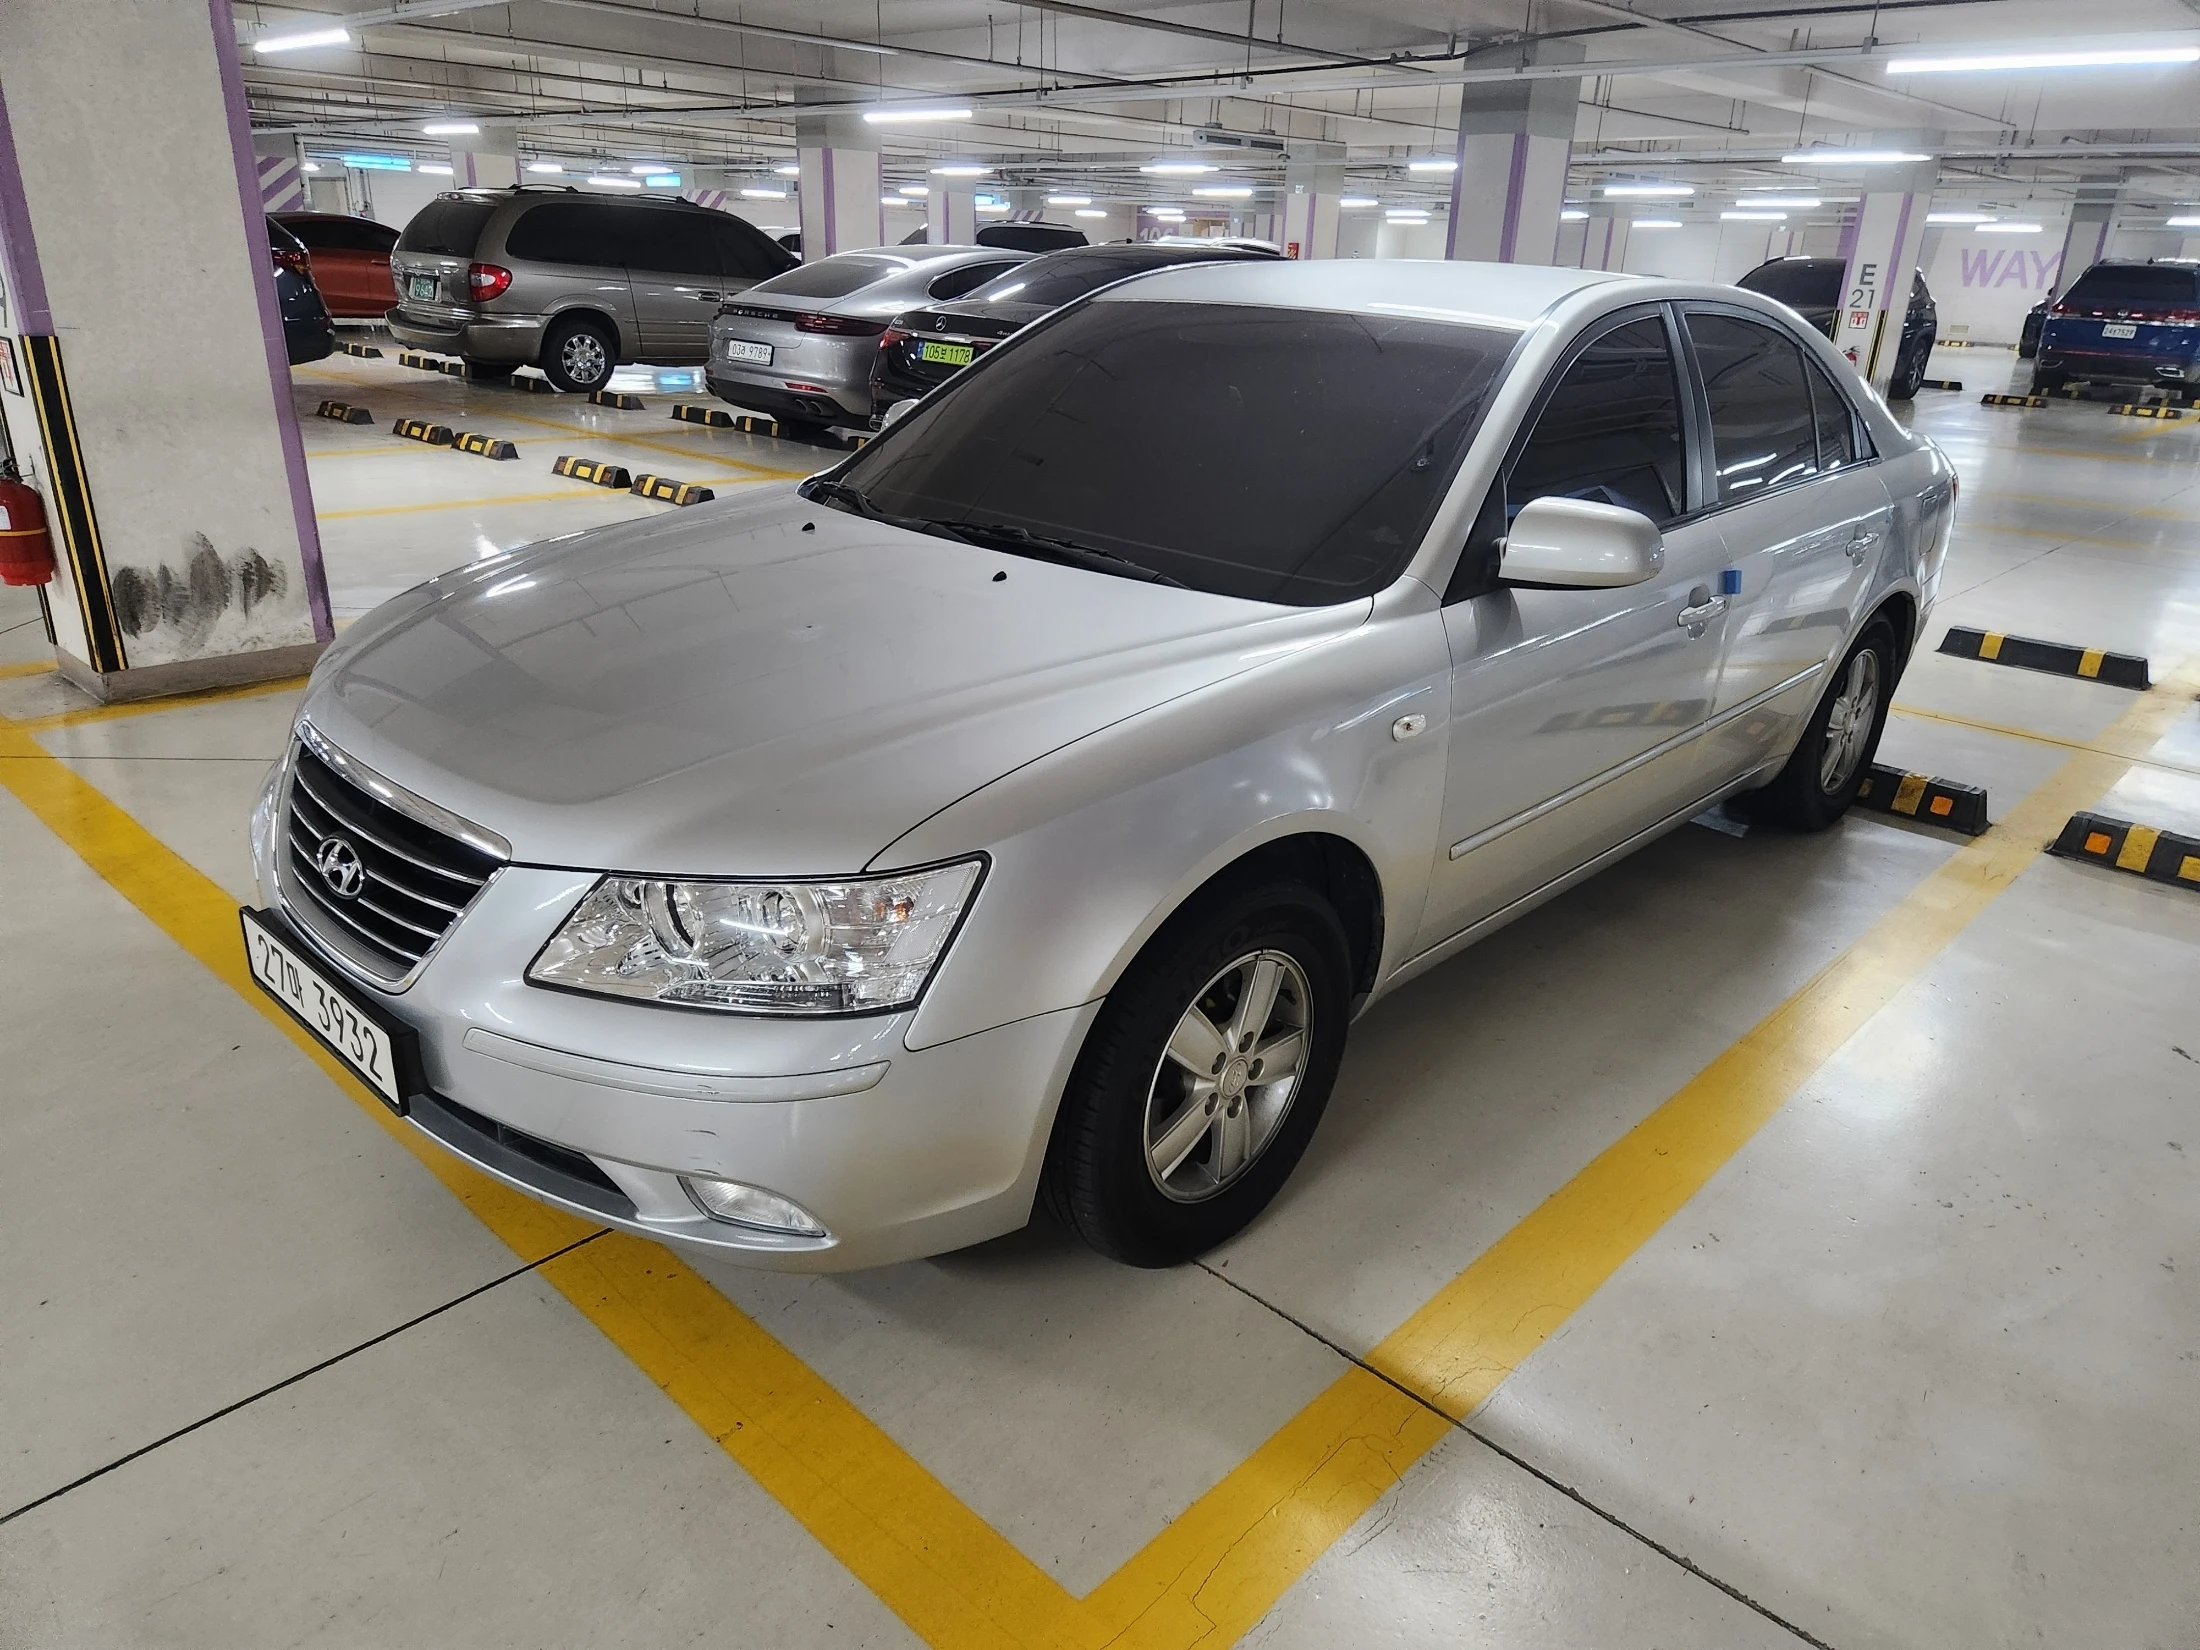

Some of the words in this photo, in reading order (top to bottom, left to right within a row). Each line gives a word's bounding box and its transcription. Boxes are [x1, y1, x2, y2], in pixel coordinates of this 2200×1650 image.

[1859, 263, 1877, 286] E
[1961, 248, 2062, 289] WAY
[1849, 288, 1875, 309] 21
[733, 308, 778, 319] PORSCHE
[749, 345, 768, 359] 9789
[924, 344, 946, 360] 105보
[948, 347, 971, 363] 1178
[257, 934, 304, 1009] 27마
[312, 979, 383, 1083] 3932
